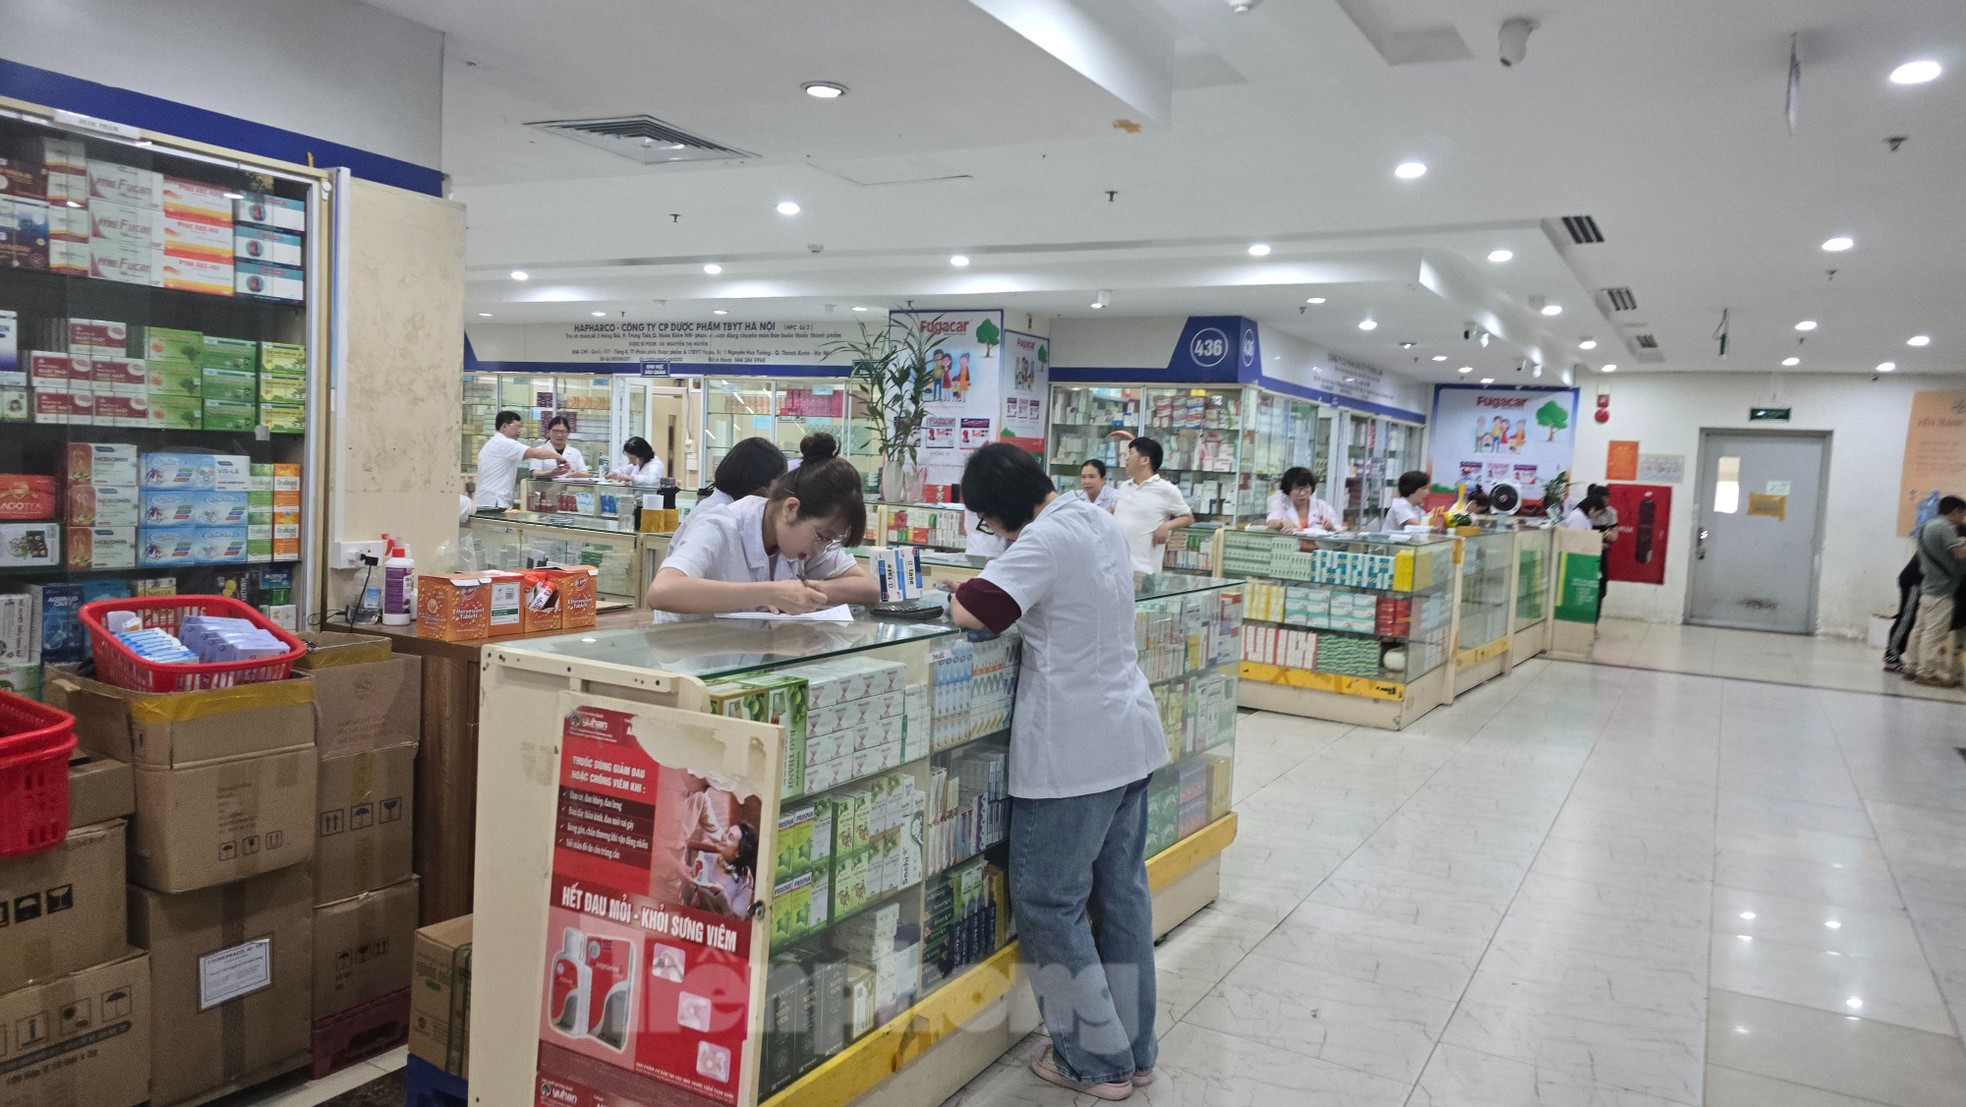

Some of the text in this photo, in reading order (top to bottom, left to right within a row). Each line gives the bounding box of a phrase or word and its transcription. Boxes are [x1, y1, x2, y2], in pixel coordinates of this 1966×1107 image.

[574, 323, 615, 332] HAPHARCO
[621, 322, 644, 332] CÔNG
[647, 322, 655, 331] TY
[658, 322, 668, 331] CP
[671, 322, 694, 332] DƯỢC
[697, 321, 720, 331] PHẨM
[723, 322, 742, 331] TBYT
[745, 321, 757, 331] HÀ
[760, 321, 775, 331] NỘI
[920, 320, 969, 335] Fugacar
[1194, 339, 1223, 356] 436
[1476, 395, 1528, 408] Fugacar
[452, 607, 485, 615] Effervescent
[582, 717, 608, 731] yuhan
[573, 755, 593, 768] THUỐC
[631, 767, 645, 779] ĐAU
[571, 770, 589, 783] HOẶC
[590, 772, 612, 787] CHỐNG
[613, 778, 629, 790] VIÊM
[630, 782, 642, 793] KHI
[778, 817, 794, 830] ROSPAN
[796, 811, 814, 822] PROSPAN
[794, 877, 811, 888] PROSPAN
[562, 882, 582, 909] HẾT
[584, 894, 607, 916] ĐAU
[609, 893, 631, 923] MỎI
[641, 903, 668, 933] KHỎI
[671, 915, 703, 943] SƯNG
[707, 923, 737, 952] VIÊM
[552, 1084, 577, 1104] yuhan
